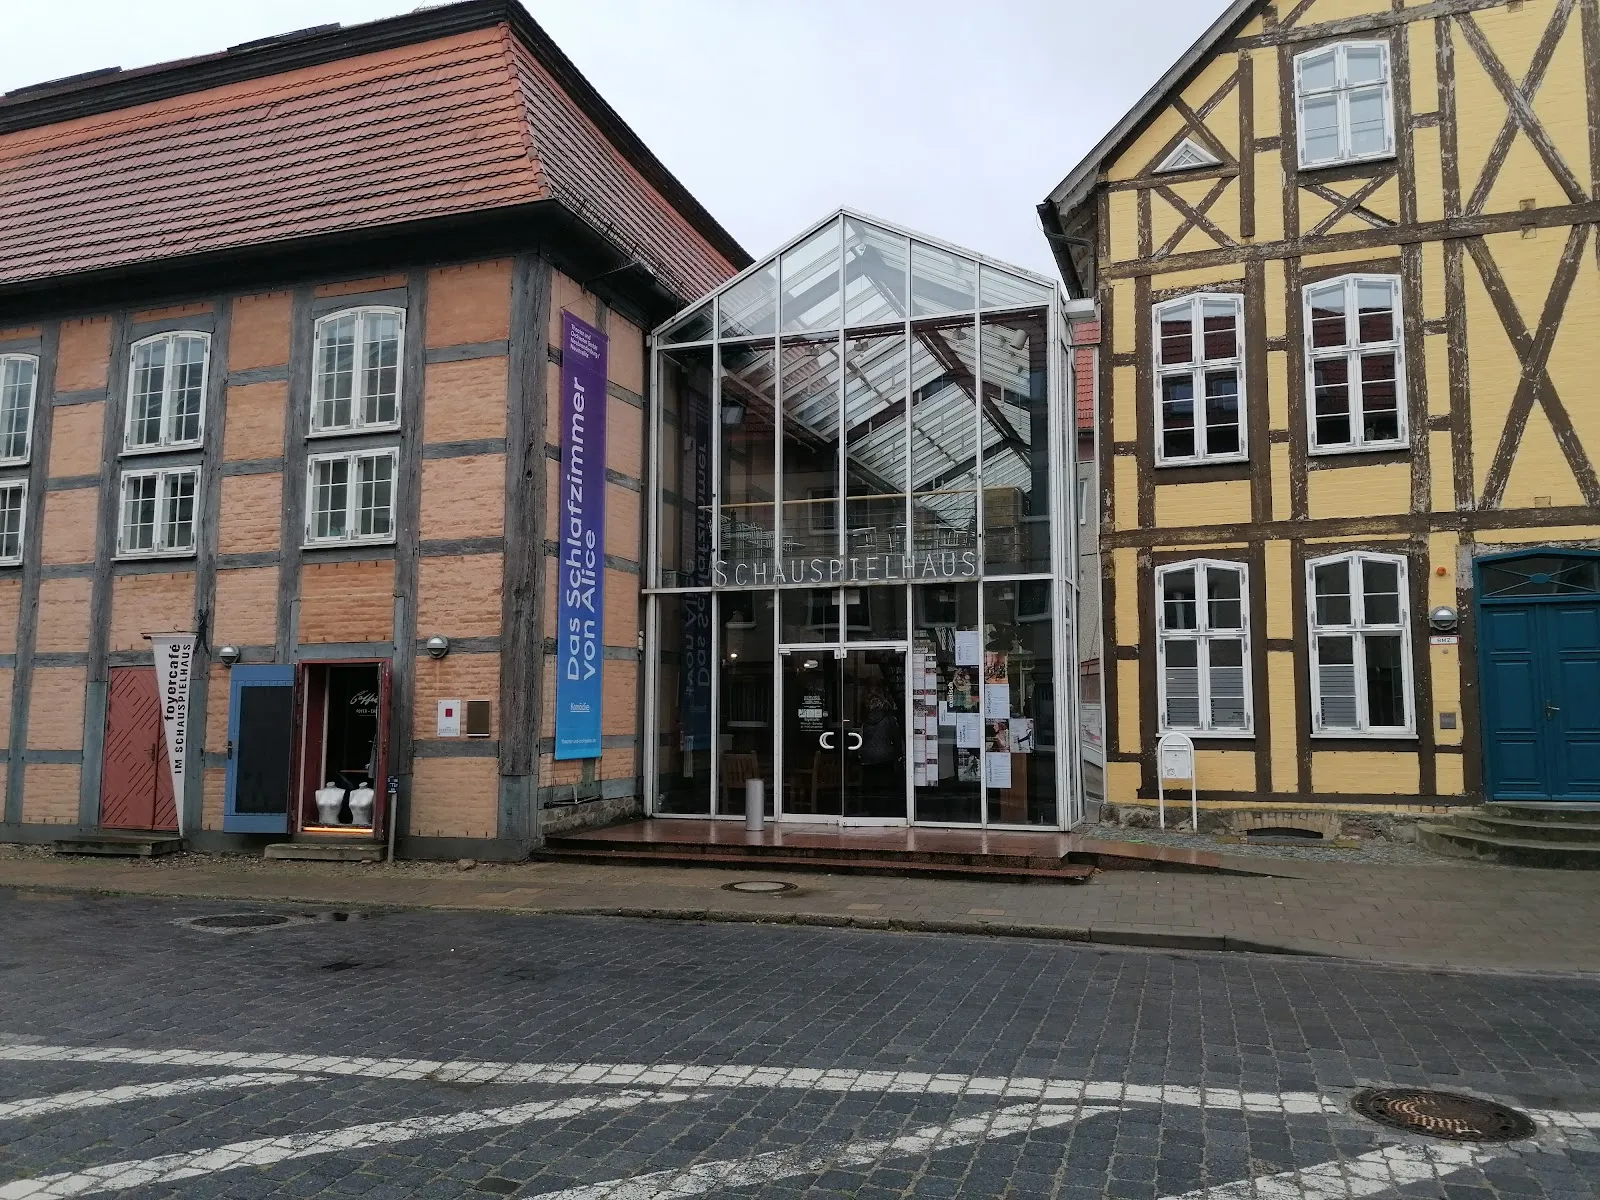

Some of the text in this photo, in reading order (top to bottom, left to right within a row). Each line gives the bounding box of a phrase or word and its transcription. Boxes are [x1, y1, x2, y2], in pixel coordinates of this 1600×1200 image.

[570, 330, 588, 345] Orchester
[566, 376, 585, 681] Das Schlafzimmer
[582, 529, 597, 681] von Alice
[713, 551, 976, 587] SCHAUSPIELHAUS
[164, 644, 181, 722] foyercafé
[175, 644, 191, 774] IM SCHAUSPIELHAUS
[570, 702, 590, 711] Komödie
